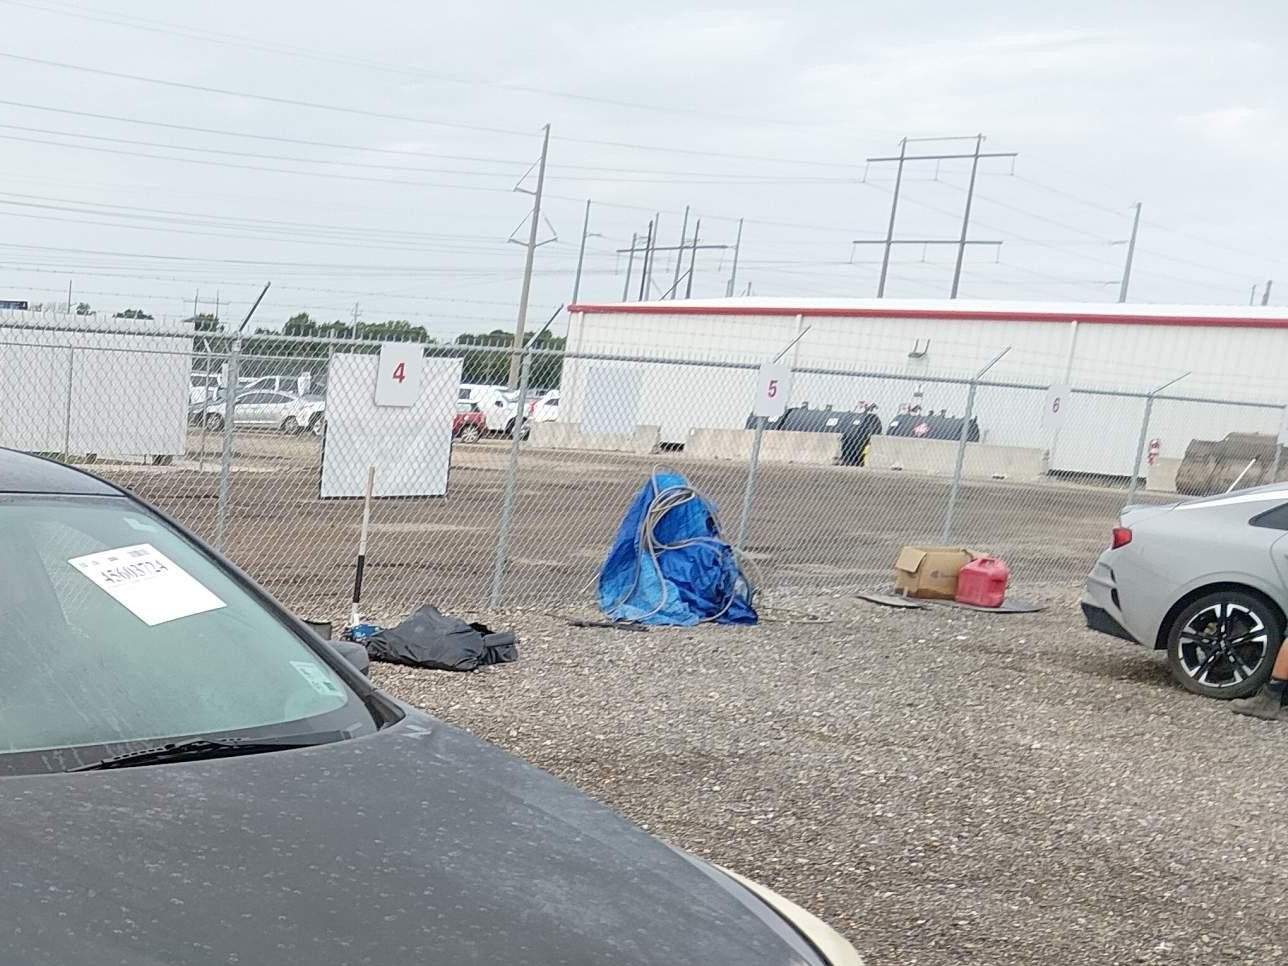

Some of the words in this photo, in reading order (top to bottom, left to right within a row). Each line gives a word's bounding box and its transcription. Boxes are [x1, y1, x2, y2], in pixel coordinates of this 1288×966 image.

[392, 362, 406, 383] 4
[768, 379, 778, 398] 5
[1052, 397, 1060, 414] 6
